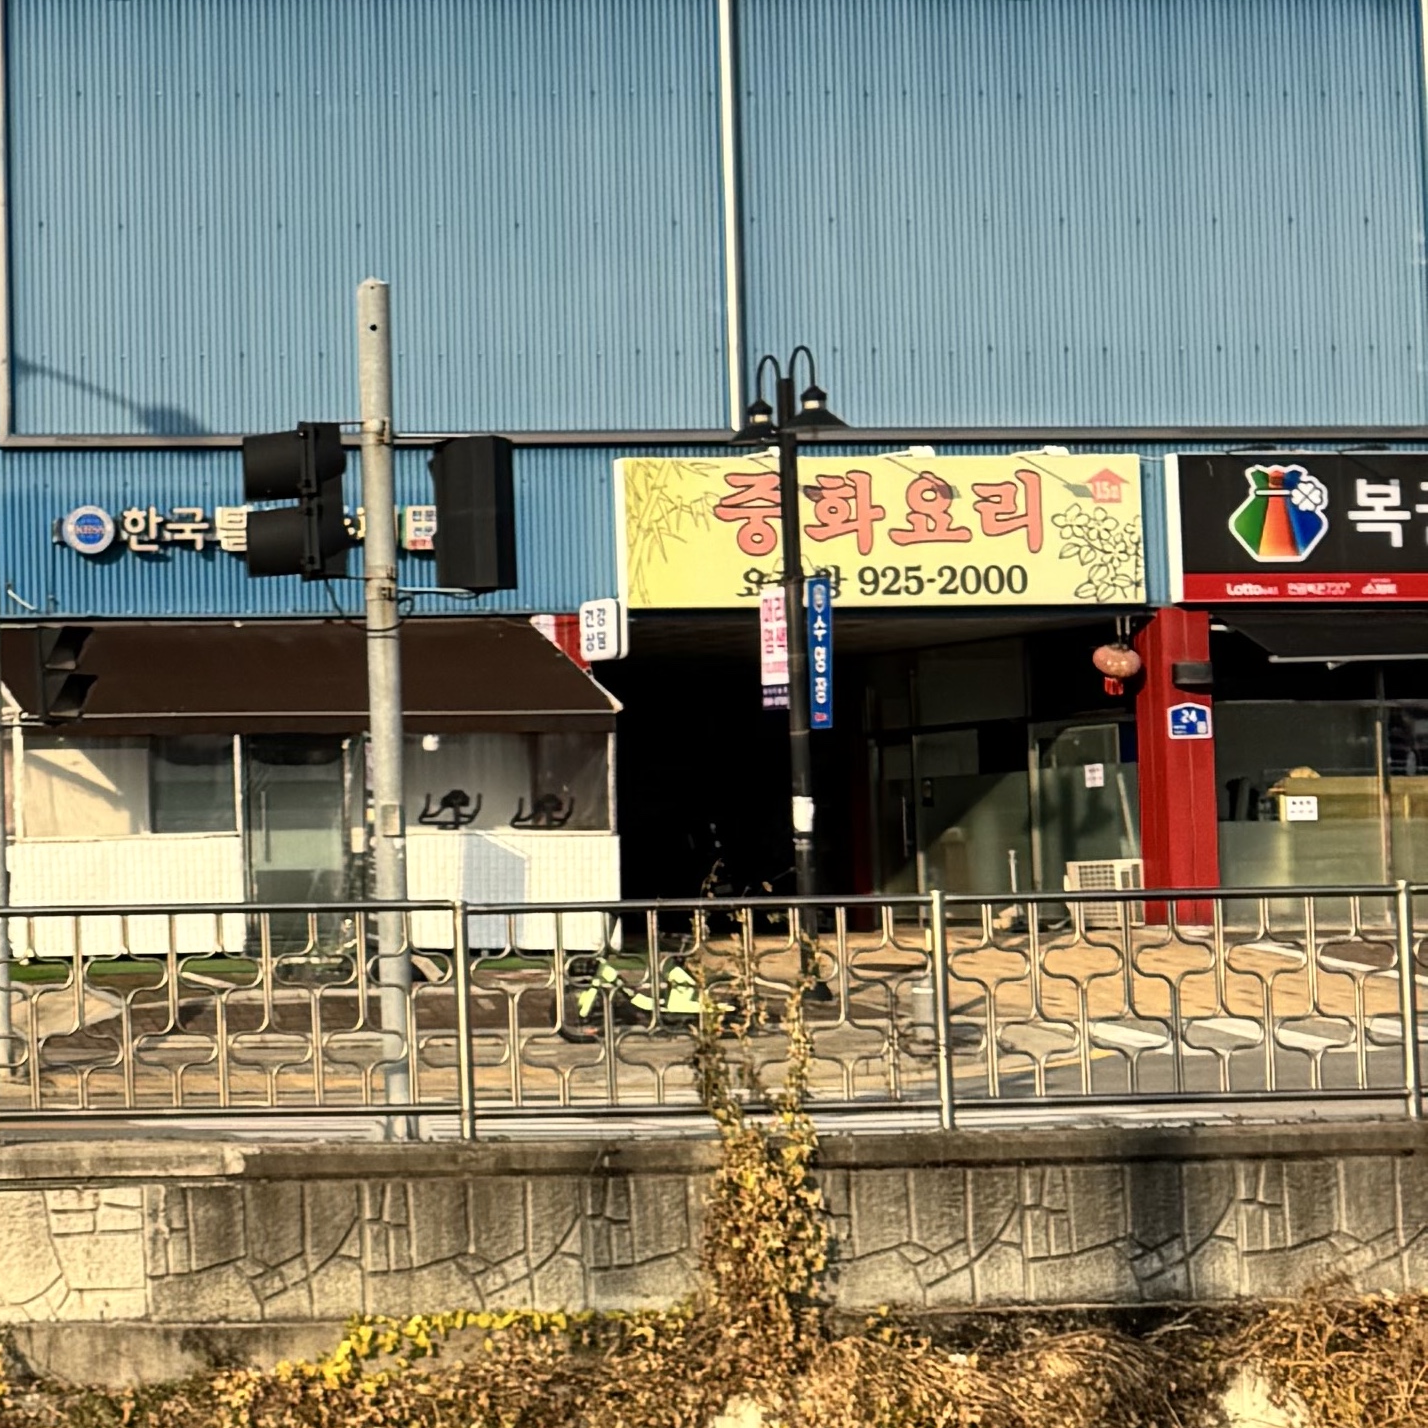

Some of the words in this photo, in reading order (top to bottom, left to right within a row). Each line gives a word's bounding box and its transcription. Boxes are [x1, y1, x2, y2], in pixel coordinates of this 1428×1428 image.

[713, 469, 1044, 556] 중화요리
[1347, 478, 1428, 548] 복
[857, 565, 1028, 597] 925-2000
[1180, 709, 1198, 723] 24
